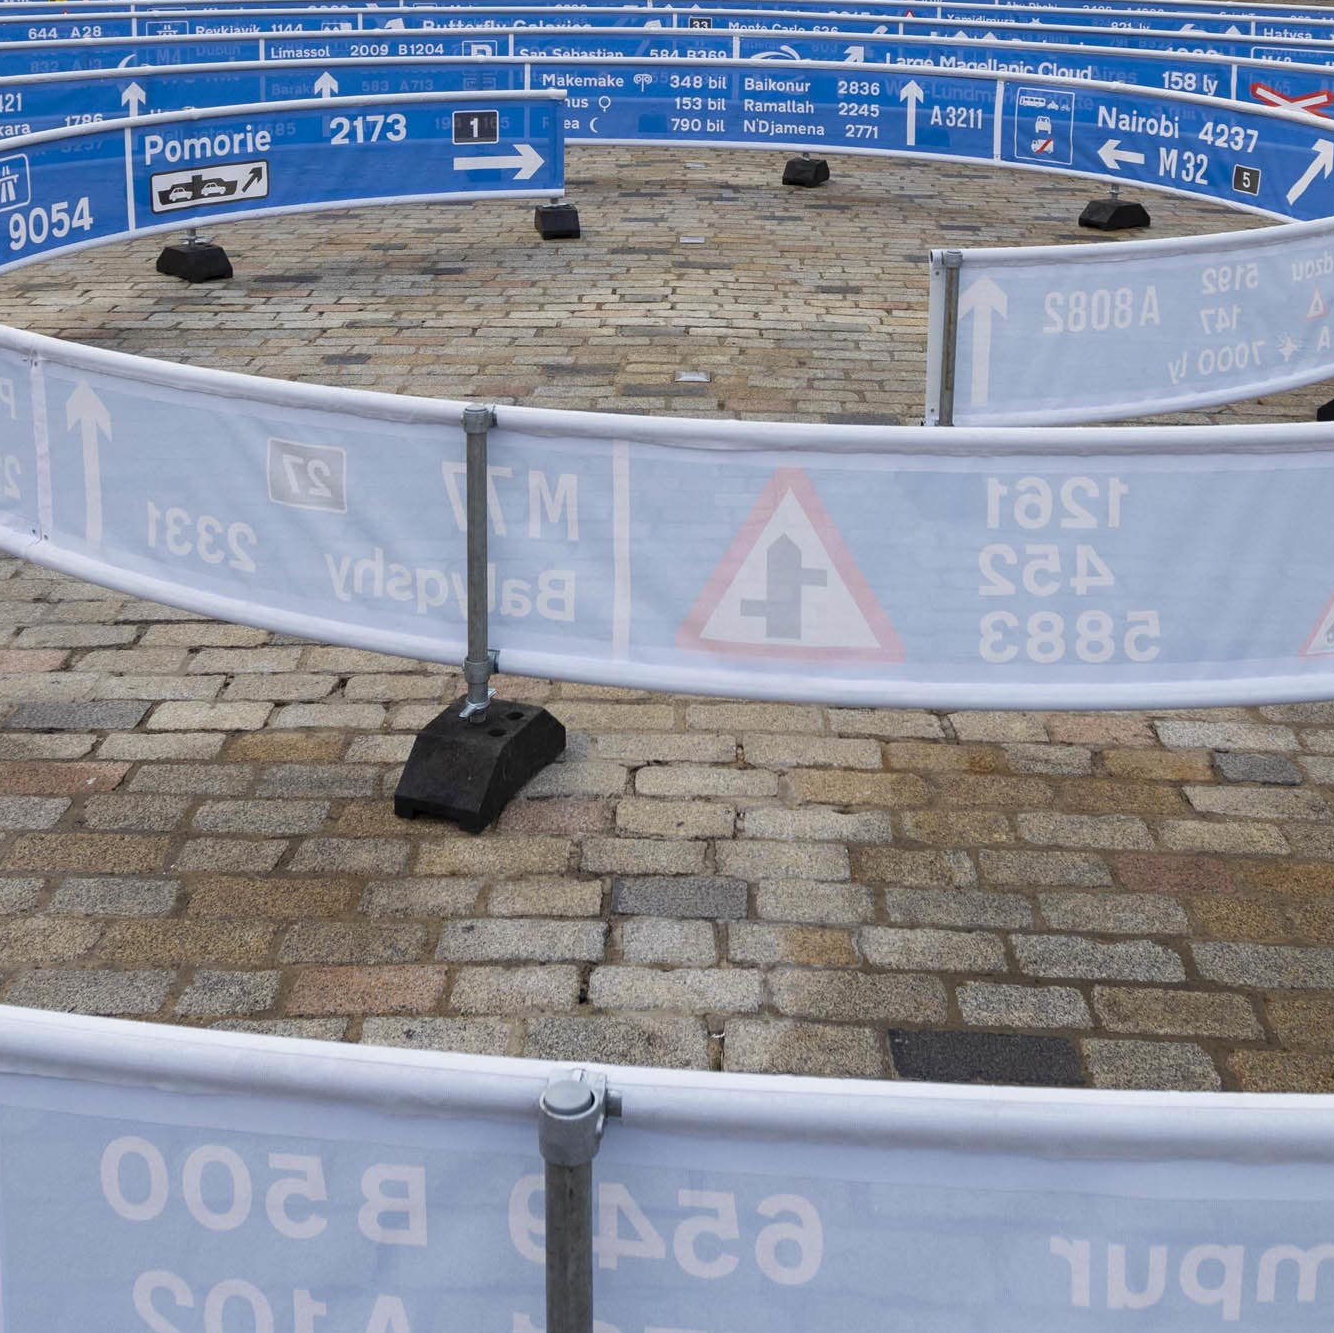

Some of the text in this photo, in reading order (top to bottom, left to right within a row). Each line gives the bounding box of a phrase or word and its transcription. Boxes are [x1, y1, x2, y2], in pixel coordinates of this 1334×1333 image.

[28, 26, 102, 39] 644 A28
[271, 43, 444, 58] Limassol 2009 B1204
[886, 52, 934, 66] Large
[1038, 61, 1092, 79] Cloud
[542, 73, 727, 90] Makemake 348 bil
[745, 78, 811, 93] Baikonur
[838, 82, 880, 96] 2836
[1162, 71, 1218, 95] 158 ly
[674, 97, 726, 111] 153 bil
[745, 99, 880, 117] Ramallah 2245
[671, 119, 725, 132] 790 bil
[930, 106, 982, 129] A3211
[470, 118, 479, 138] 1
[845, 125, 879, 139] 2771
[1097, 105, 1179, 138] Nairobi
[1198, 121, 1259, 153] 4237
[144, 125, 271, 165] Pomorie
[330, 113, 407, 145] 2173
[1159, 146, 1208, 185] M32
[1242, 171, 1251, 189] 5
[9, 197, 93, 251] 9054
